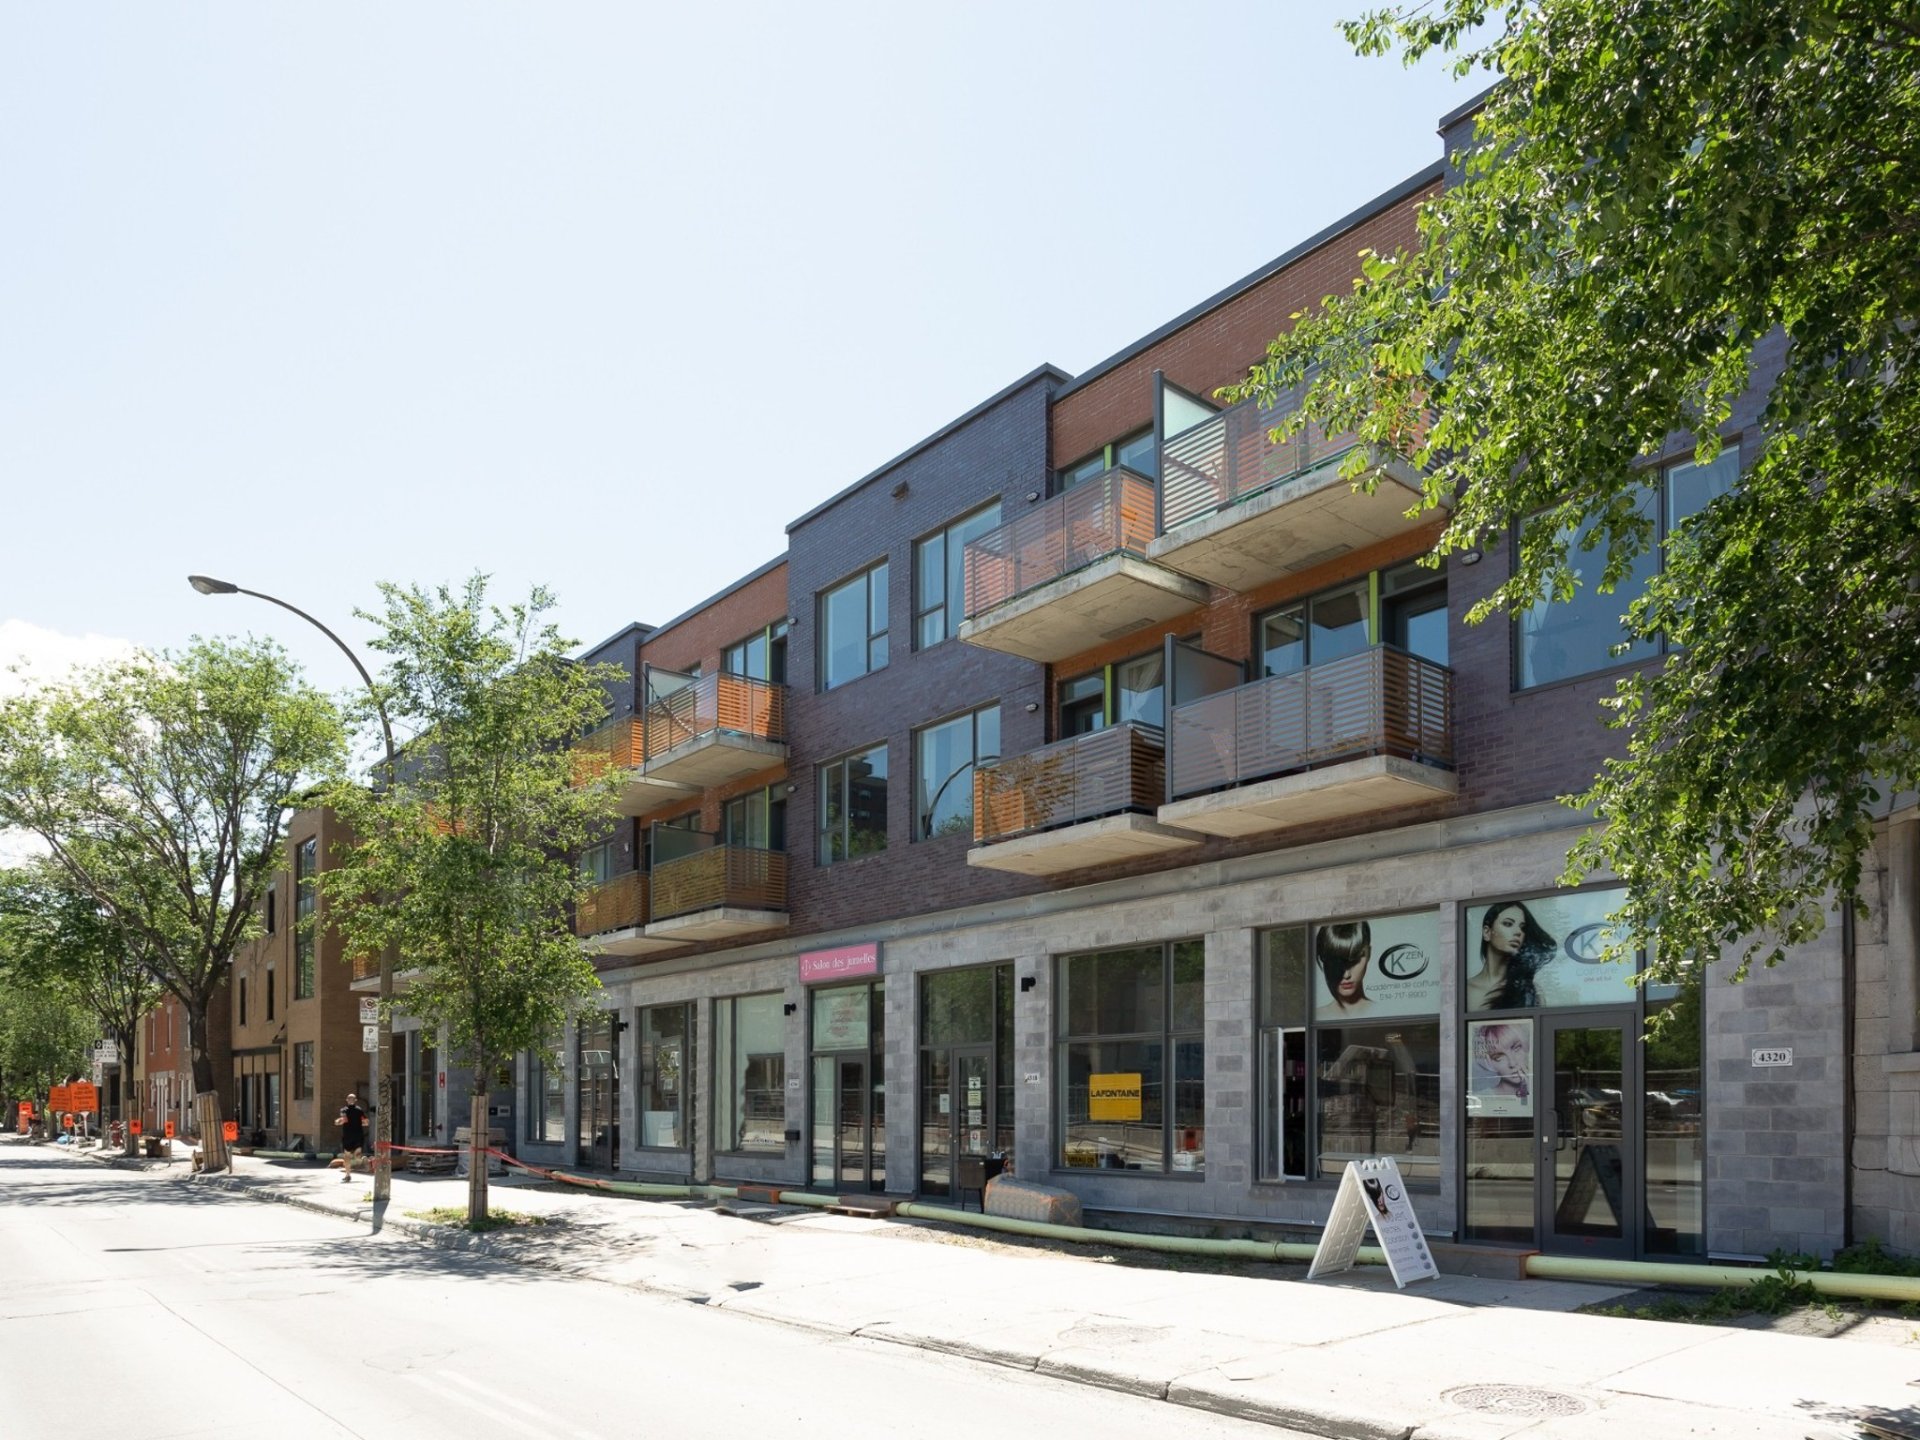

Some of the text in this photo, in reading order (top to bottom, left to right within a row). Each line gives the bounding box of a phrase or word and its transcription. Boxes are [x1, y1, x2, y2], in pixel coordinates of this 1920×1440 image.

[813, 952, 876, 970] Salon des jumelles
[1402, 981, 1412, 989] de
[1759, 1052, 1786, 1062] 4320
[1090, 1089, 1140, 1098] LAFONTAINE
